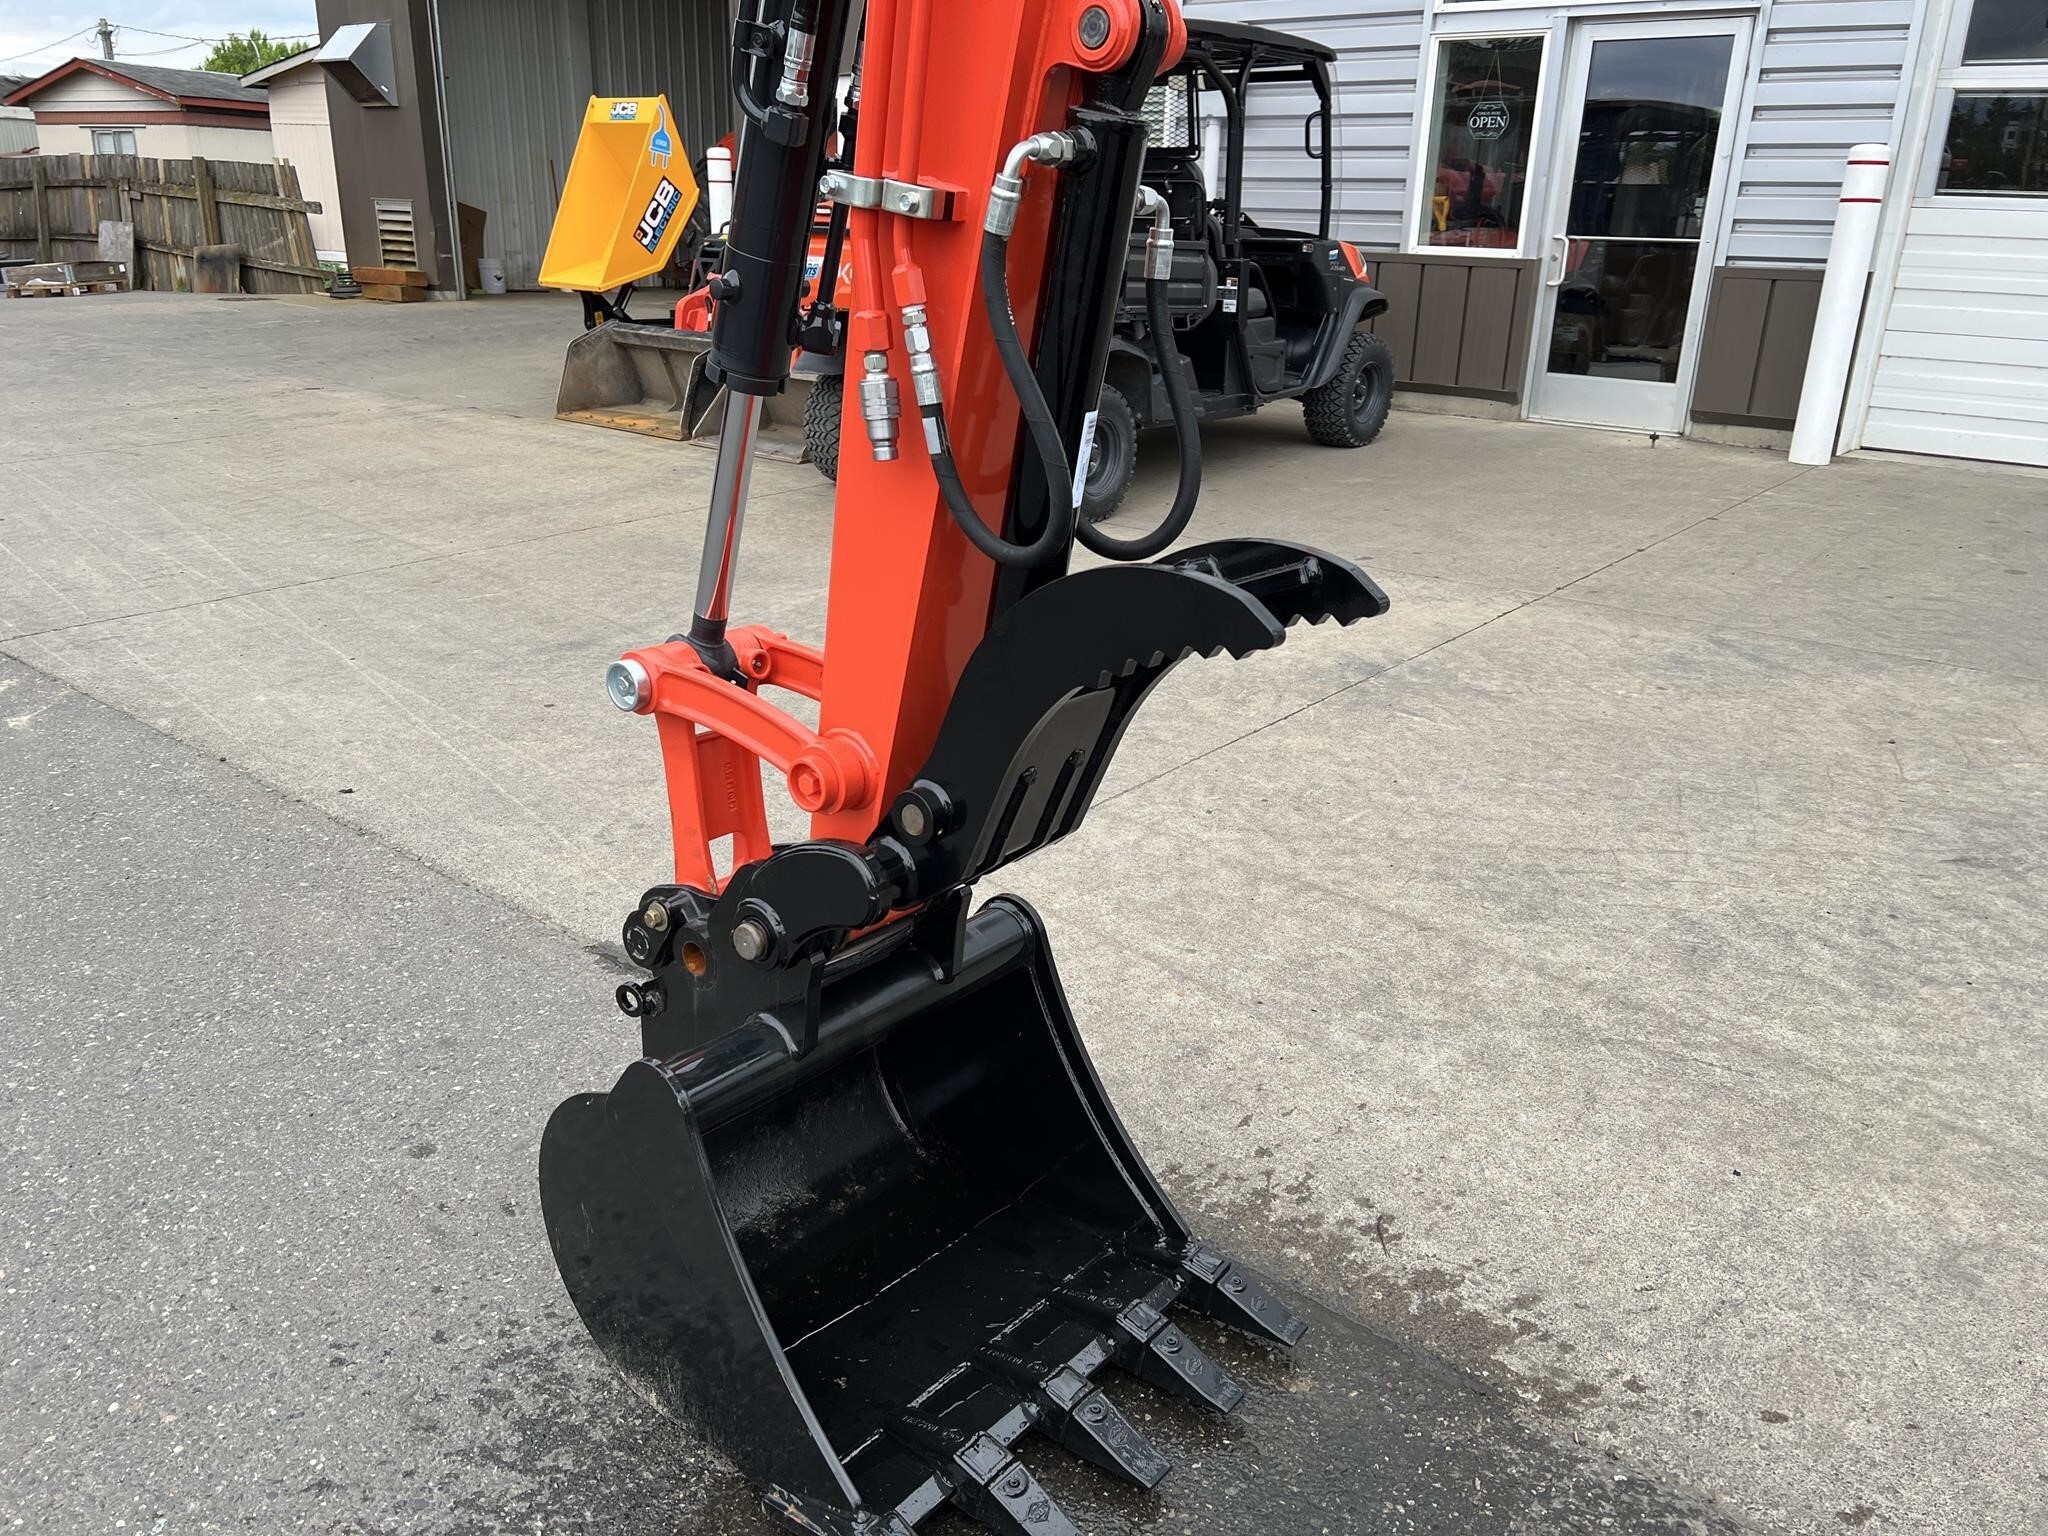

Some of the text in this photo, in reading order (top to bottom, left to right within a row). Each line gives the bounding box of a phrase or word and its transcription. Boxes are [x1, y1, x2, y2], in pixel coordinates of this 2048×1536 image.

[611, 102, 638, 115] JCB
[1470, 116, 1506, 128] OPEN
[640, 179, 675, 246] JCB
[647, 190, 681, 252] ELECTRIC
